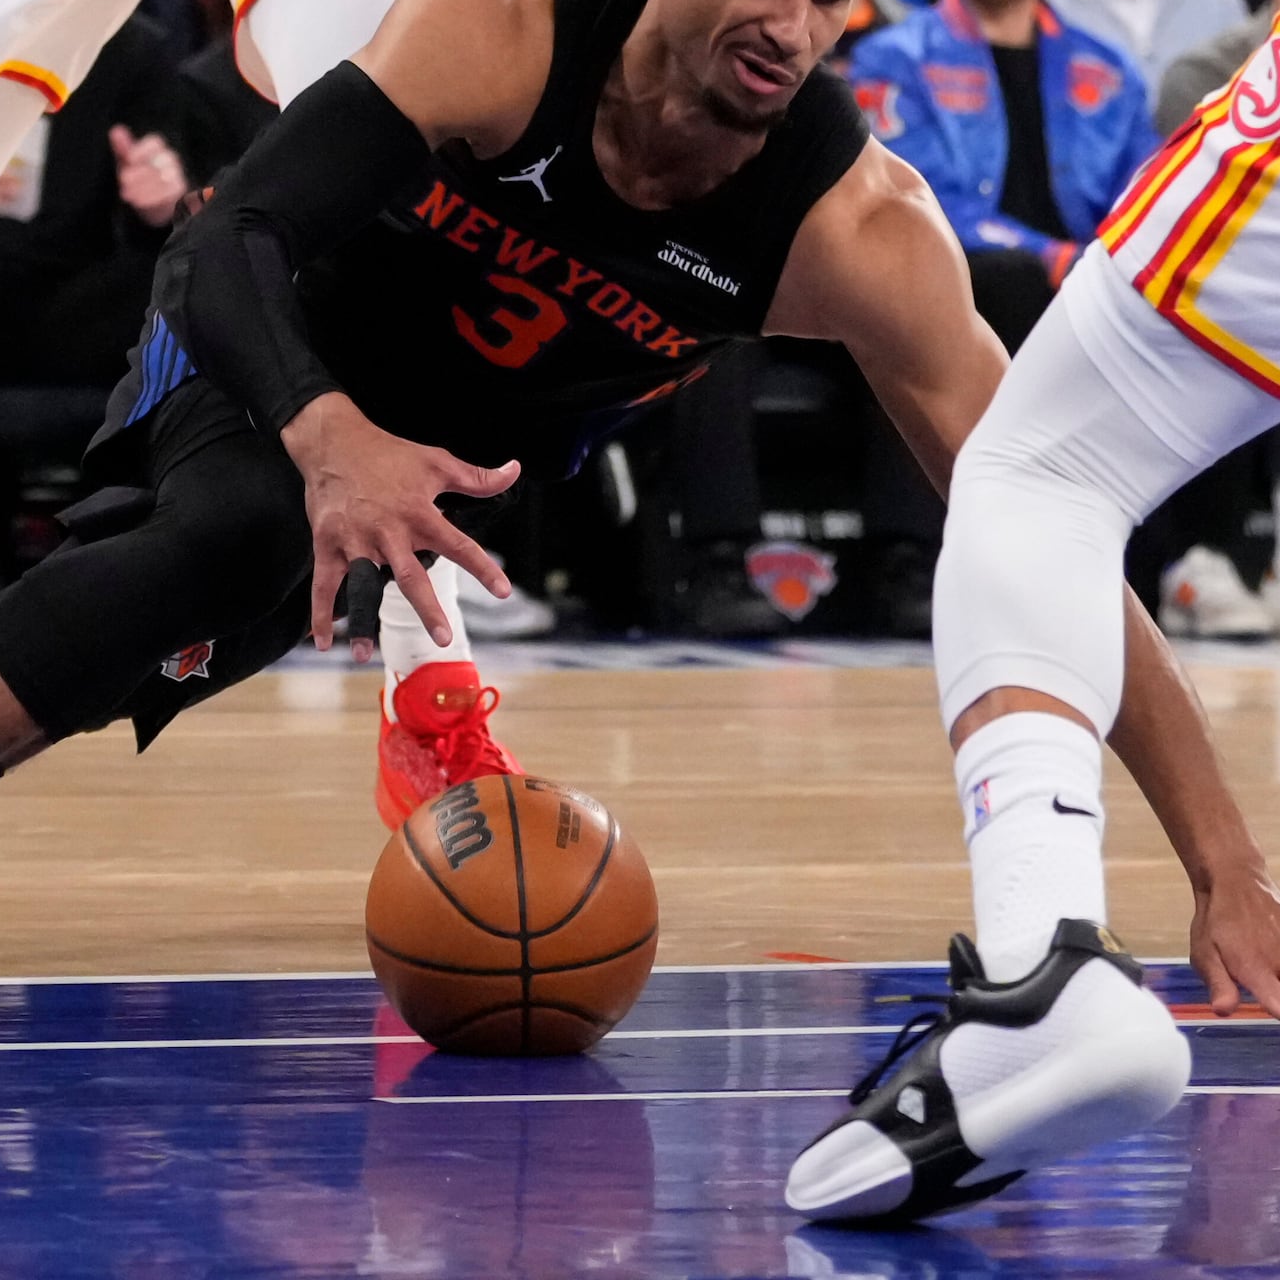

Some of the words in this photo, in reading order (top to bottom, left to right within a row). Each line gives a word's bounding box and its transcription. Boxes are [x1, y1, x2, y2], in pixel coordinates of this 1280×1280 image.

[414, 180, 559, 273] NEW
[556, 257, 699, 358] YORK
[657, 249, 691, 272] abu
[691, 264, 742, 296] dhabi
[451, 273, 567, 368] 3
